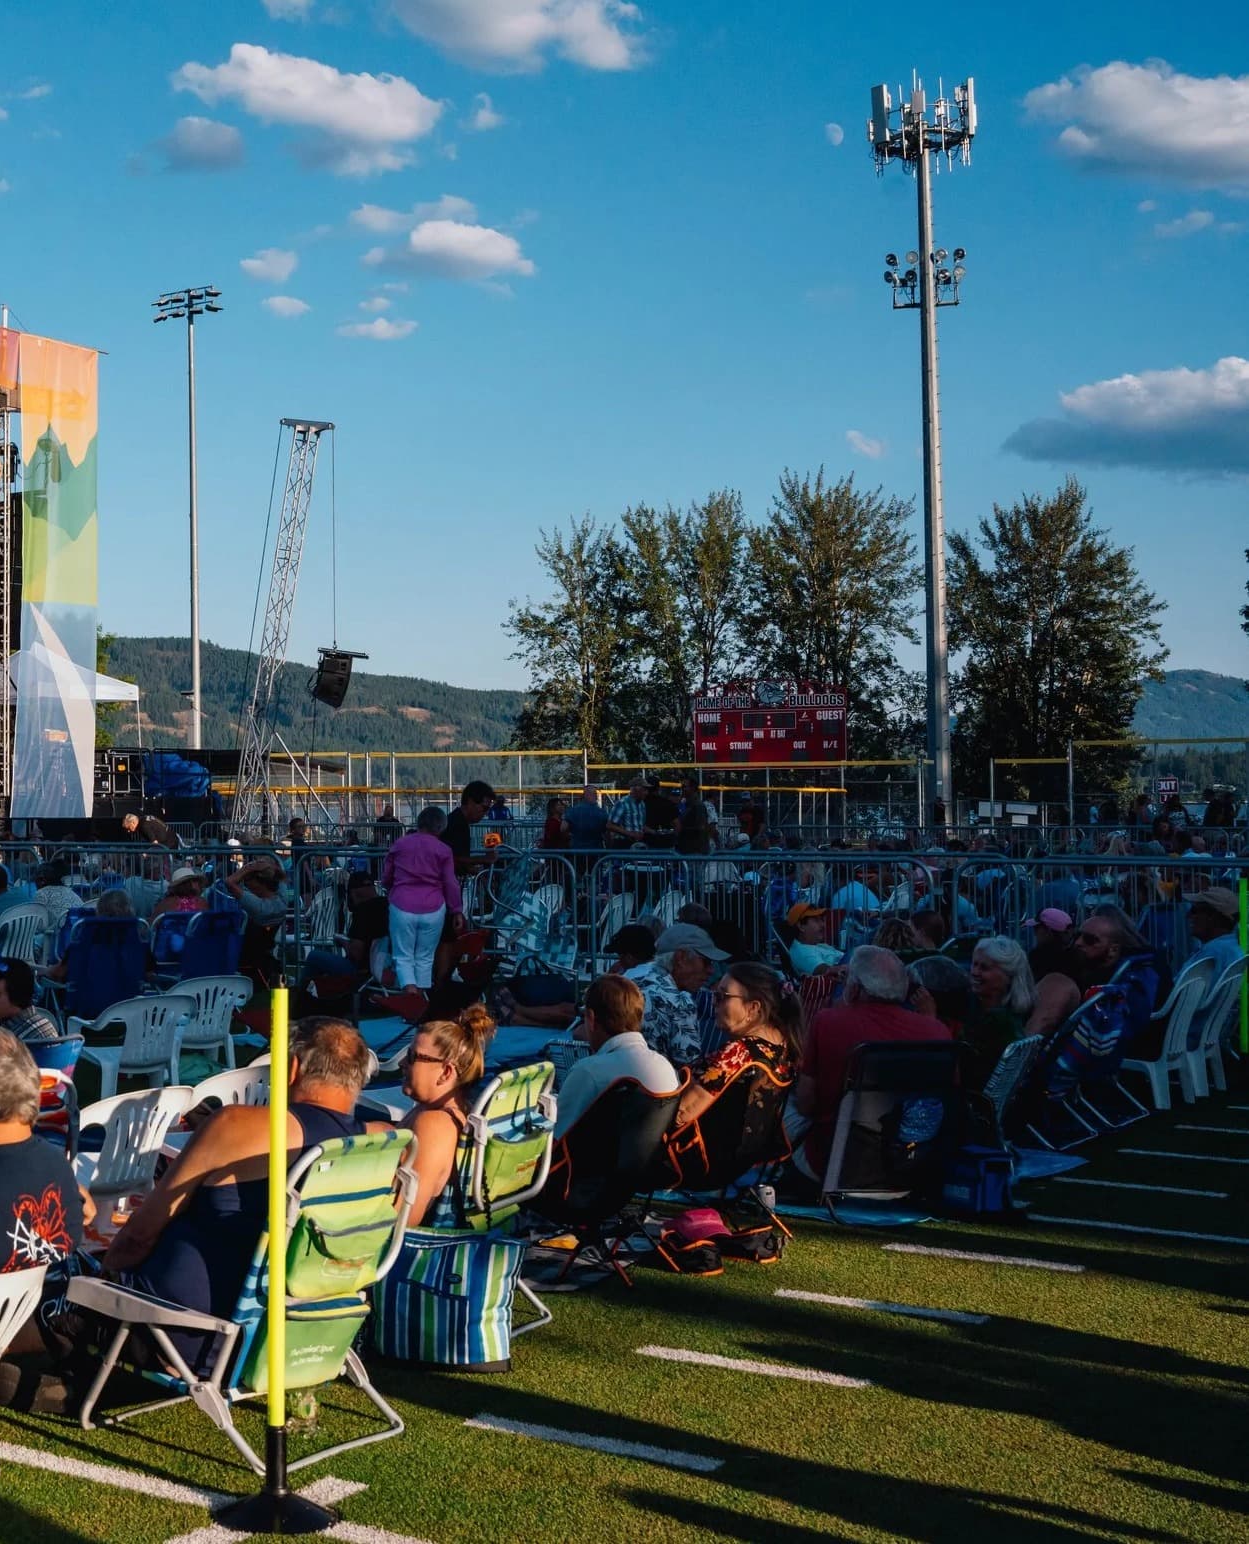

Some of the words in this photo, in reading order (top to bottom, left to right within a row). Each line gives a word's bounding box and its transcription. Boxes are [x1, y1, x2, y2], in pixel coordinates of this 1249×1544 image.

[696, 696, 721, 709] HOME
[722, 696, 734, 708] OF
[735, 695, 751, 708] THE
[789, 693, 845, 707] BULLDOGS
[697, 713, 722, 723] HOME
[816, 710, 844, 721] GUEST
[701, 742, 717, 751] BALL
[729, 741, 754, 750] STRIKE
[793, 740, 806, 749] OUT
